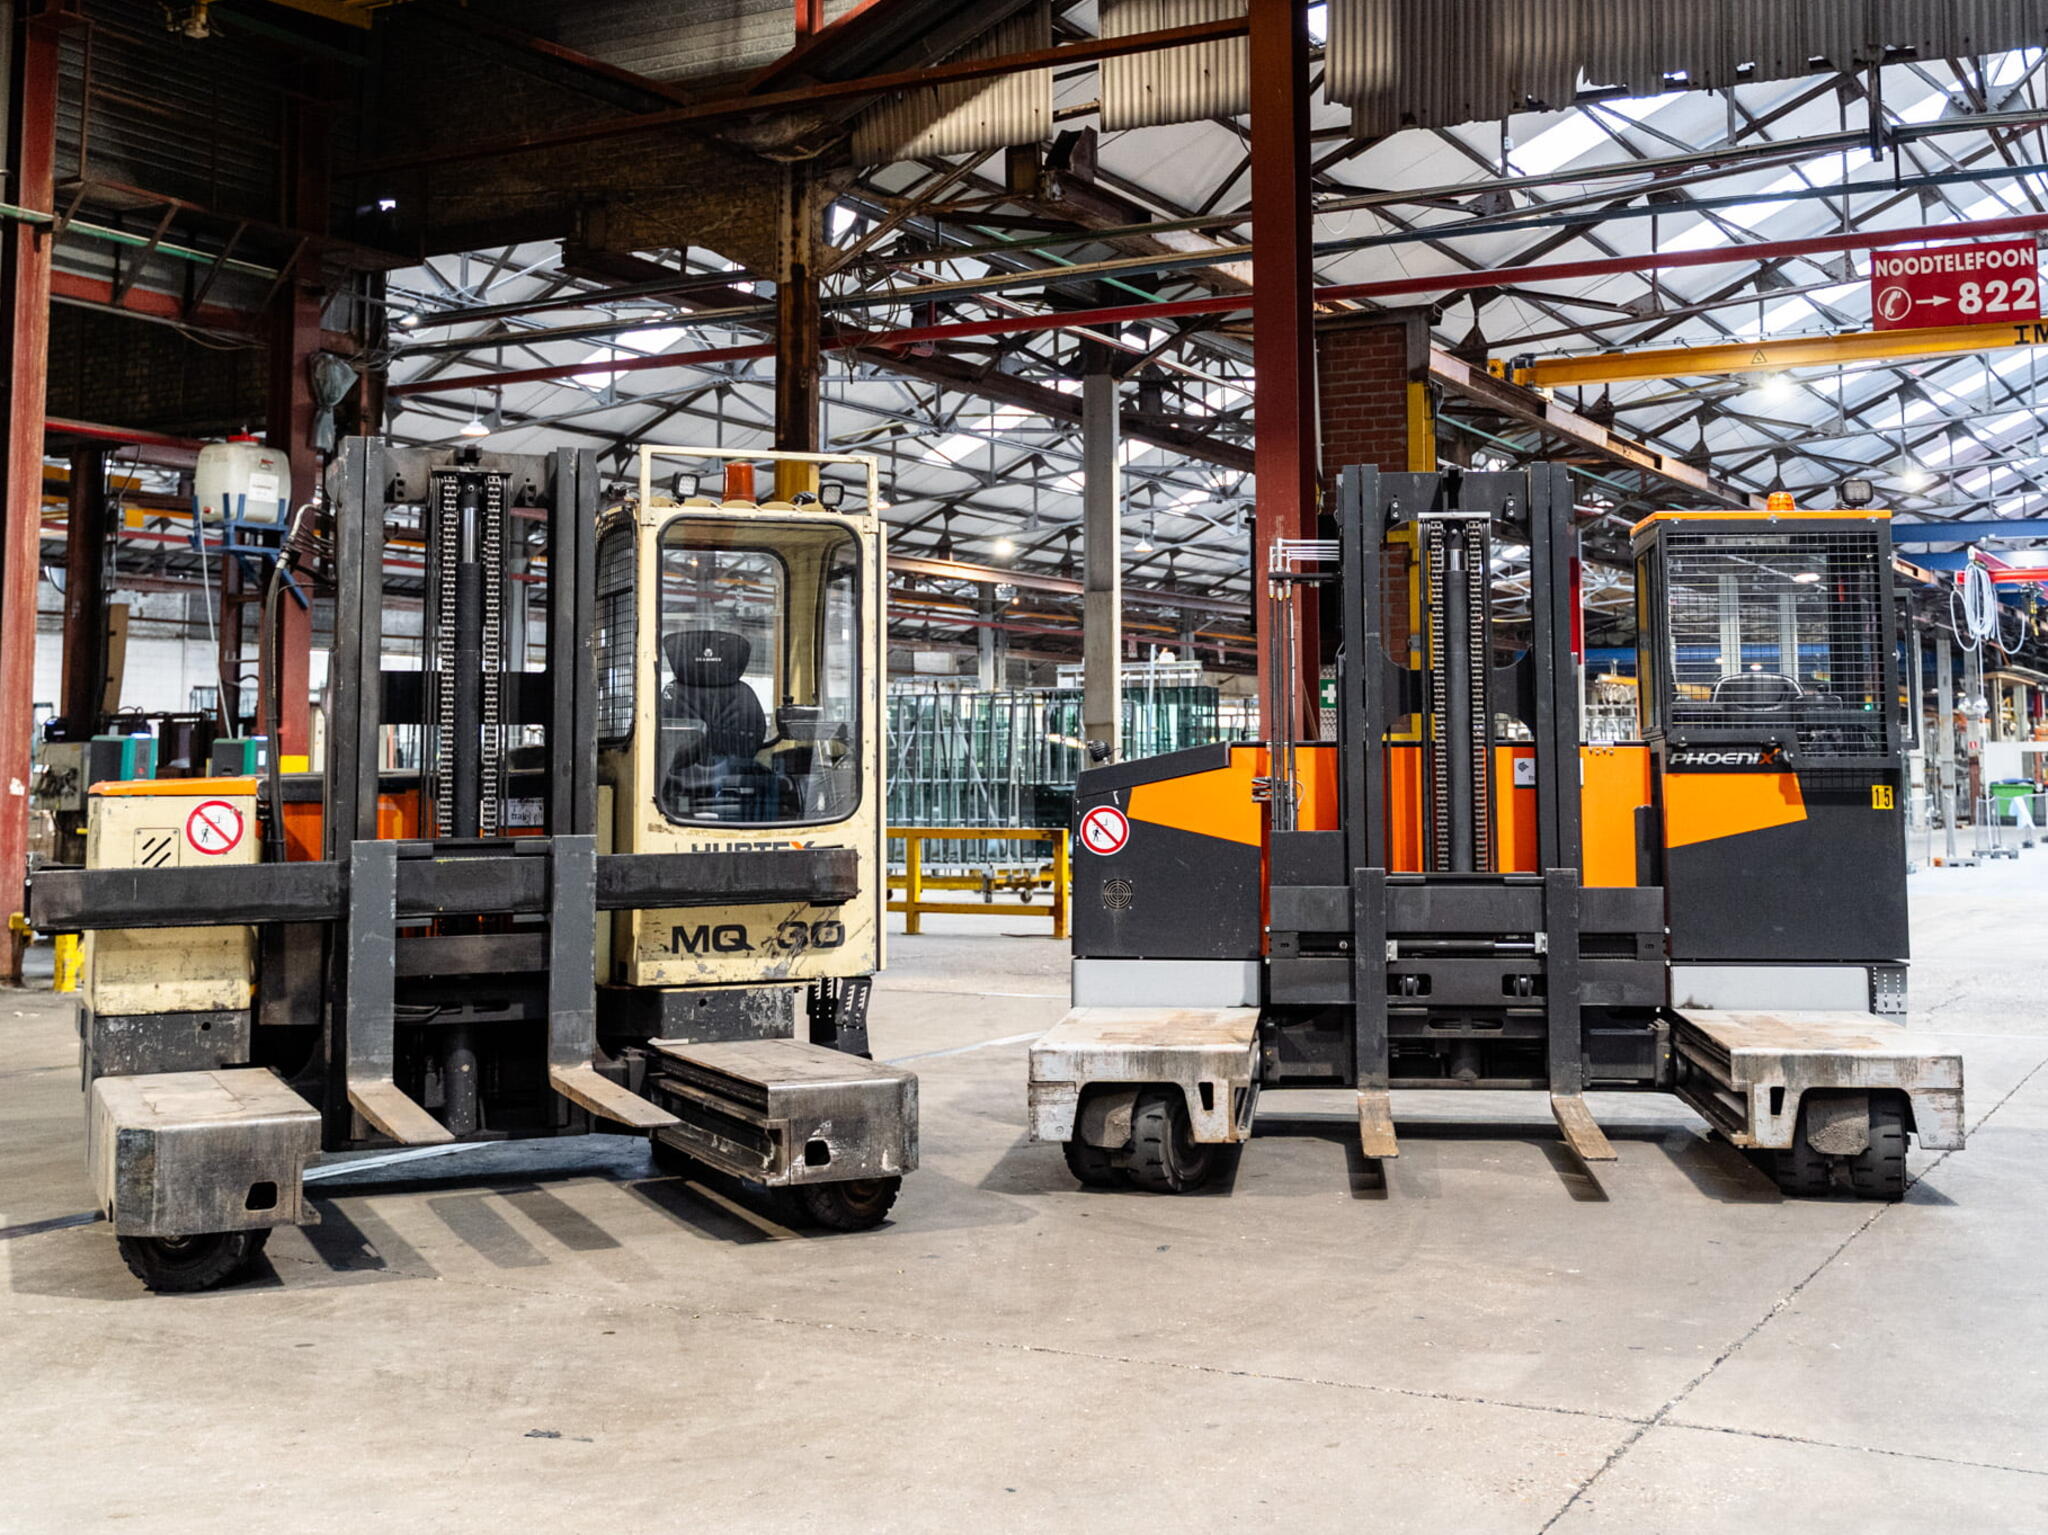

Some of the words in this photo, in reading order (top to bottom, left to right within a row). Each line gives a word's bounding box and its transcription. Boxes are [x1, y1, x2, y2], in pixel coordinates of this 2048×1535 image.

[1875, 247, 2035, 277] NOODTELEFOON
[1958, 277, 2037, 315] 822
[1669, 750, 1777, 765] PHOENIX
[1875, 787, 1890, 808] 15
[672, 924, 756, 954] MQ
[776, 920, 846, 950] 30
